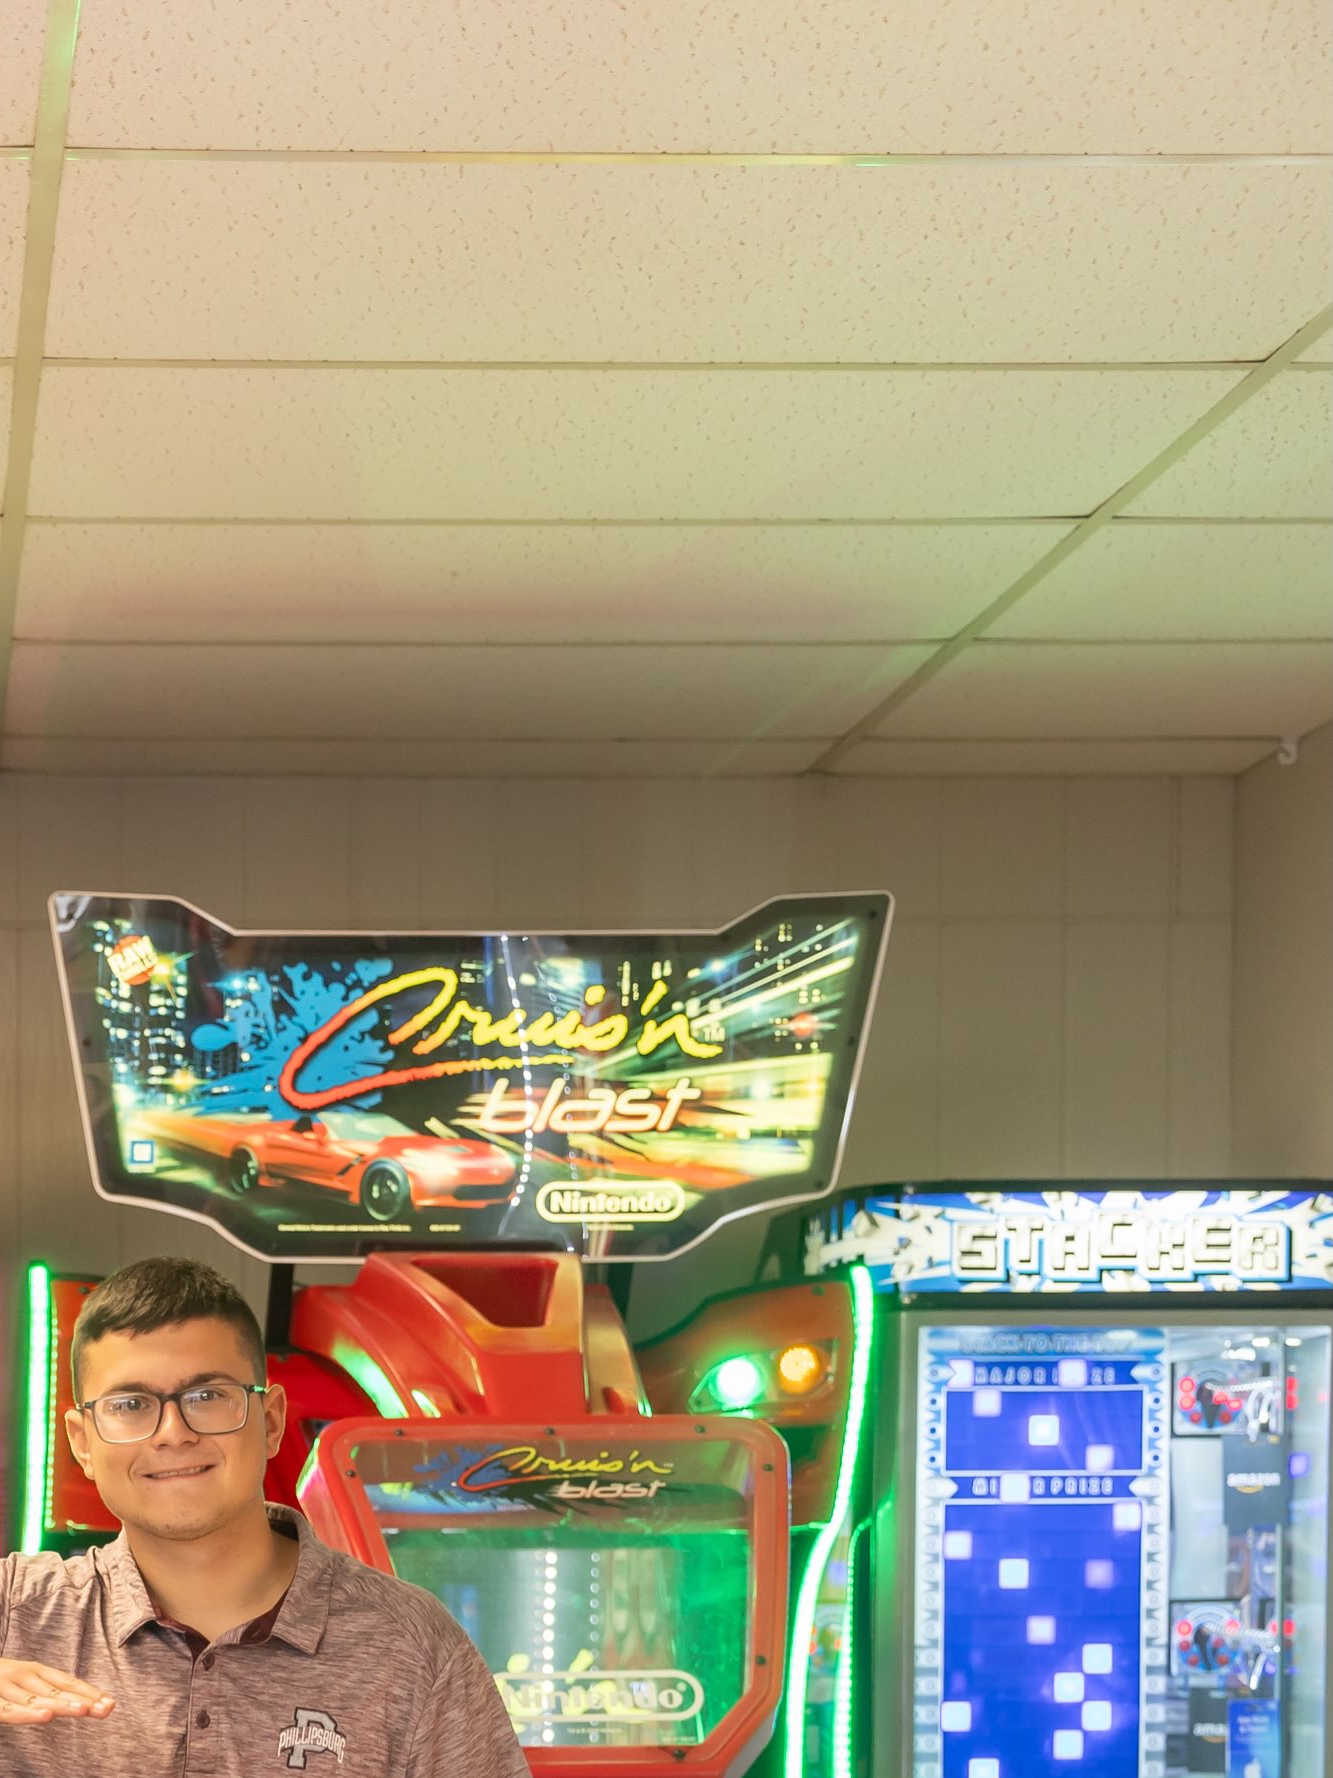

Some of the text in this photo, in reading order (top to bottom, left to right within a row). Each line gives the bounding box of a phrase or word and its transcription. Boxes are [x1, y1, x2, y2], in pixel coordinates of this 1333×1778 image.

[278, 965, 724, 1111] Cruis'n
[476, 1076, 703, 1133] blast
[549, 1190, 673, 1214] Nintendo
[953, 1209, 1290, 1279] STACKER
[457, 1446, 672, 1493] Cruis'n
[557, 1479, 667, 1499] blast
[277, 1726, 346, 1764] PHILLIPSBURG
